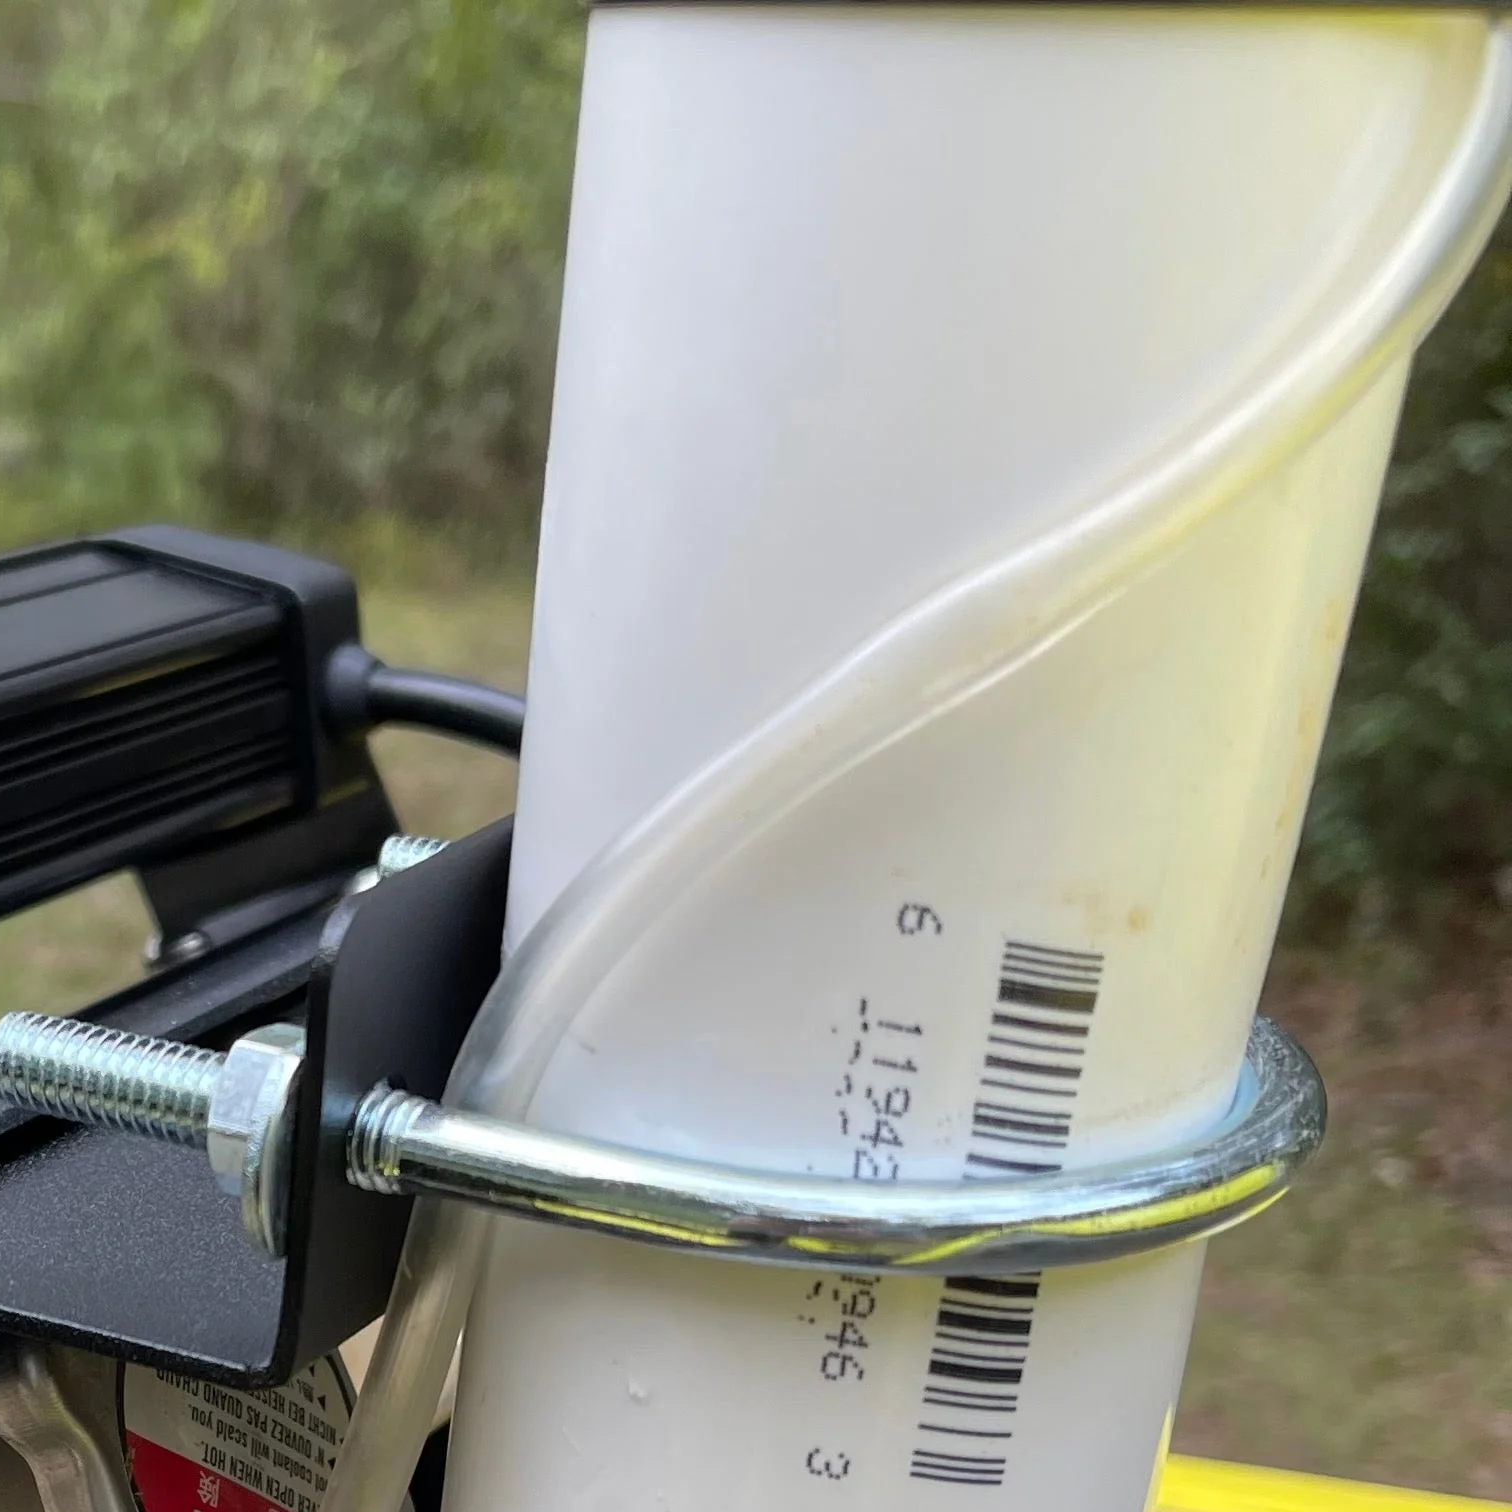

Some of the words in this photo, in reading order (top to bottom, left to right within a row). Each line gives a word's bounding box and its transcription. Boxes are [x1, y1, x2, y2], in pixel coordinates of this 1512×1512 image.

[896, 902, 943, 936] 6
[821, 1273, 881, 1381] 946
[188, 1402, 213, 1431] you.
[203, 1383, 243, 1420] QUAND
[288, 1398, 306, 1426] BEI
[216, 1413, 248, 1449] scald
[246, 1405, 268, 1434] PAS
[308, 1413, 337, 1446] NICHT
[201, 1439, 226, 1473] HOT.
[251, 1436, 271, 1461] will
[270, 1418, 312, 1460] OUVREZ
[229, 1457, 264, 1489] WHEN
[273, 1450, 313, 1485] coolant
[805, 1447, 851, 1481] 3
[267, 1477, 296, 1508] OPEN
